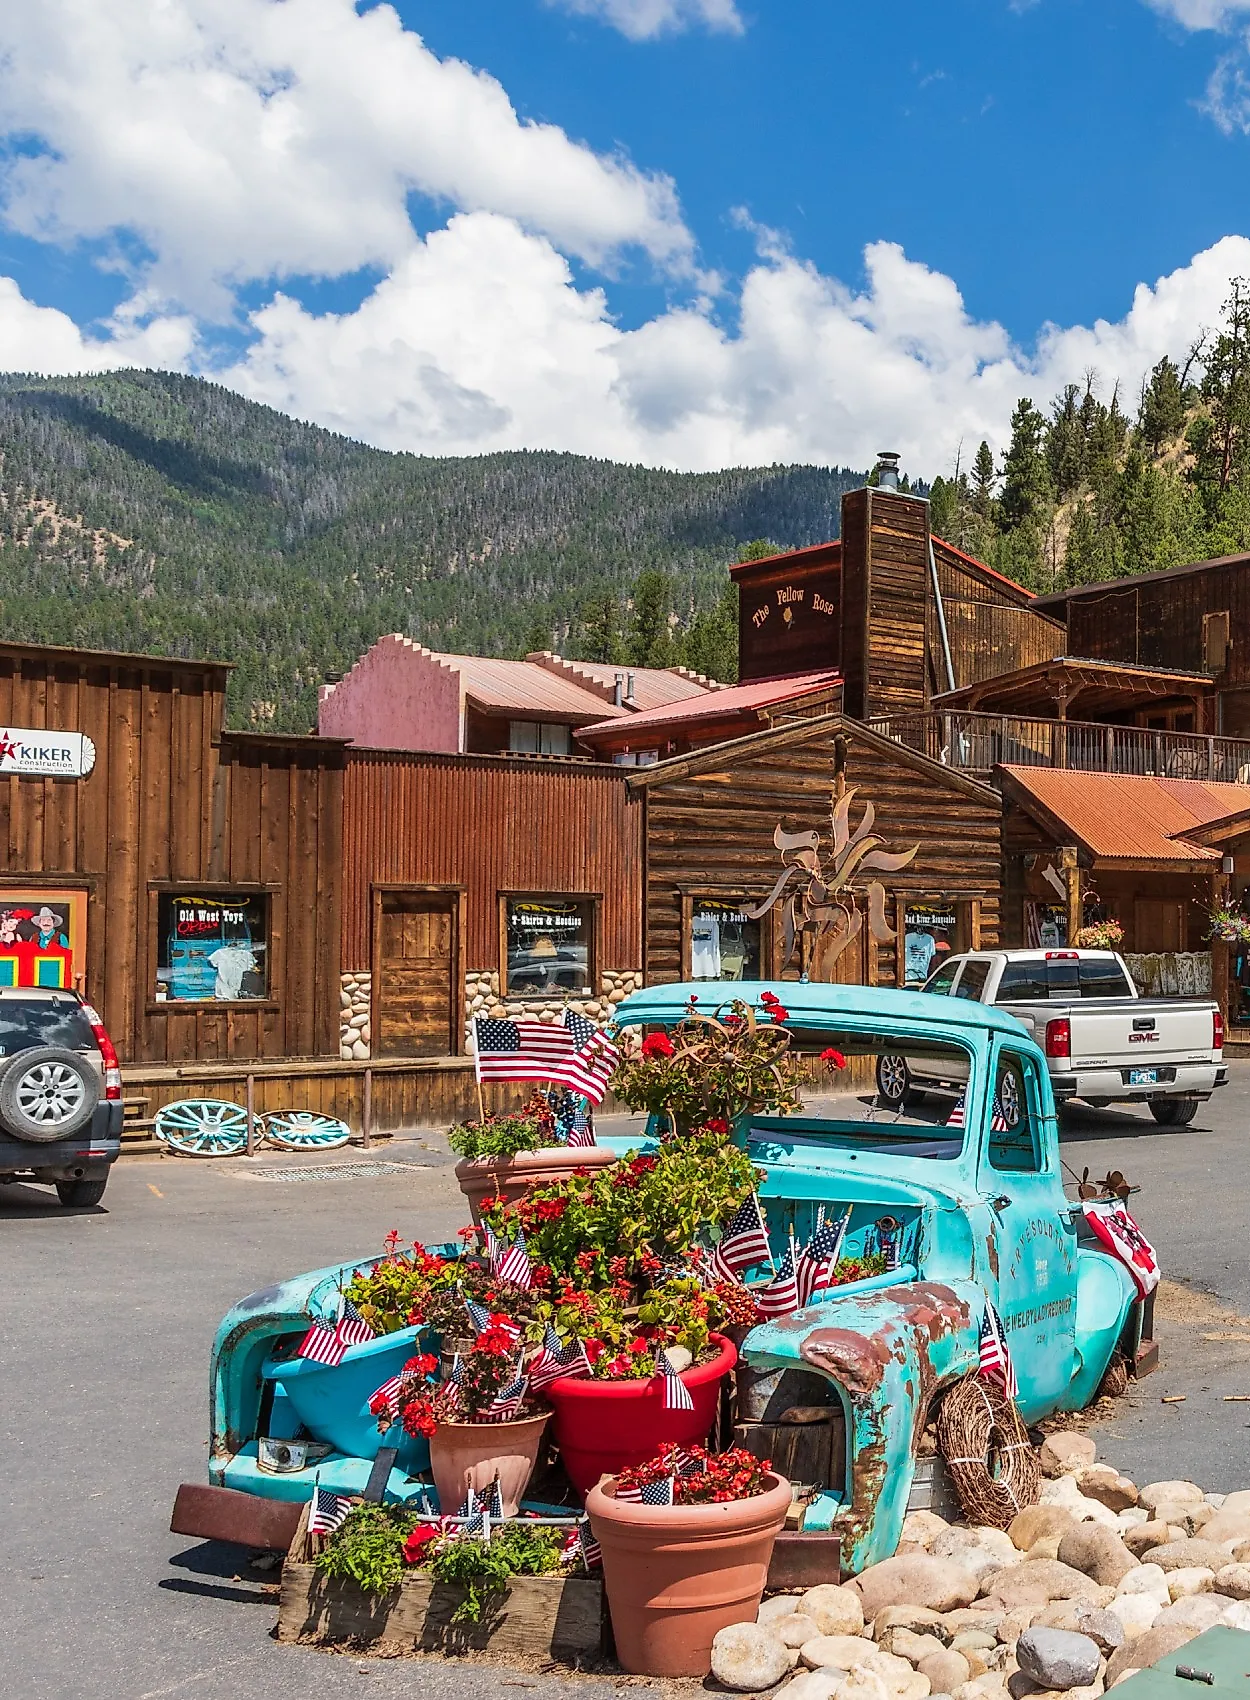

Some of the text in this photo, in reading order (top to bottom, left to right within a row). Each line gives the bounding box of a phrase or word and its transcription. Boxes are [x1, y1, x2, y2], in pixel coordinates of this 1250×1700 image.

[752, 586, 834, 628] The Yellow Rose
[20, 746, 72, 762] KIKER
[19, 759, 73, 769] construction
[179, 909, 243, 924] Old West Toys
[511, 914, 582, 926] T-Shirts & Hoodies
[700, 912, 748, 922] Bibles & Books
[905, 914, 956, 924] Red River Souvenirs
[1055, 915, 1067, 924] Gifts
[1128, 1032, 1160, 1044] GMC
